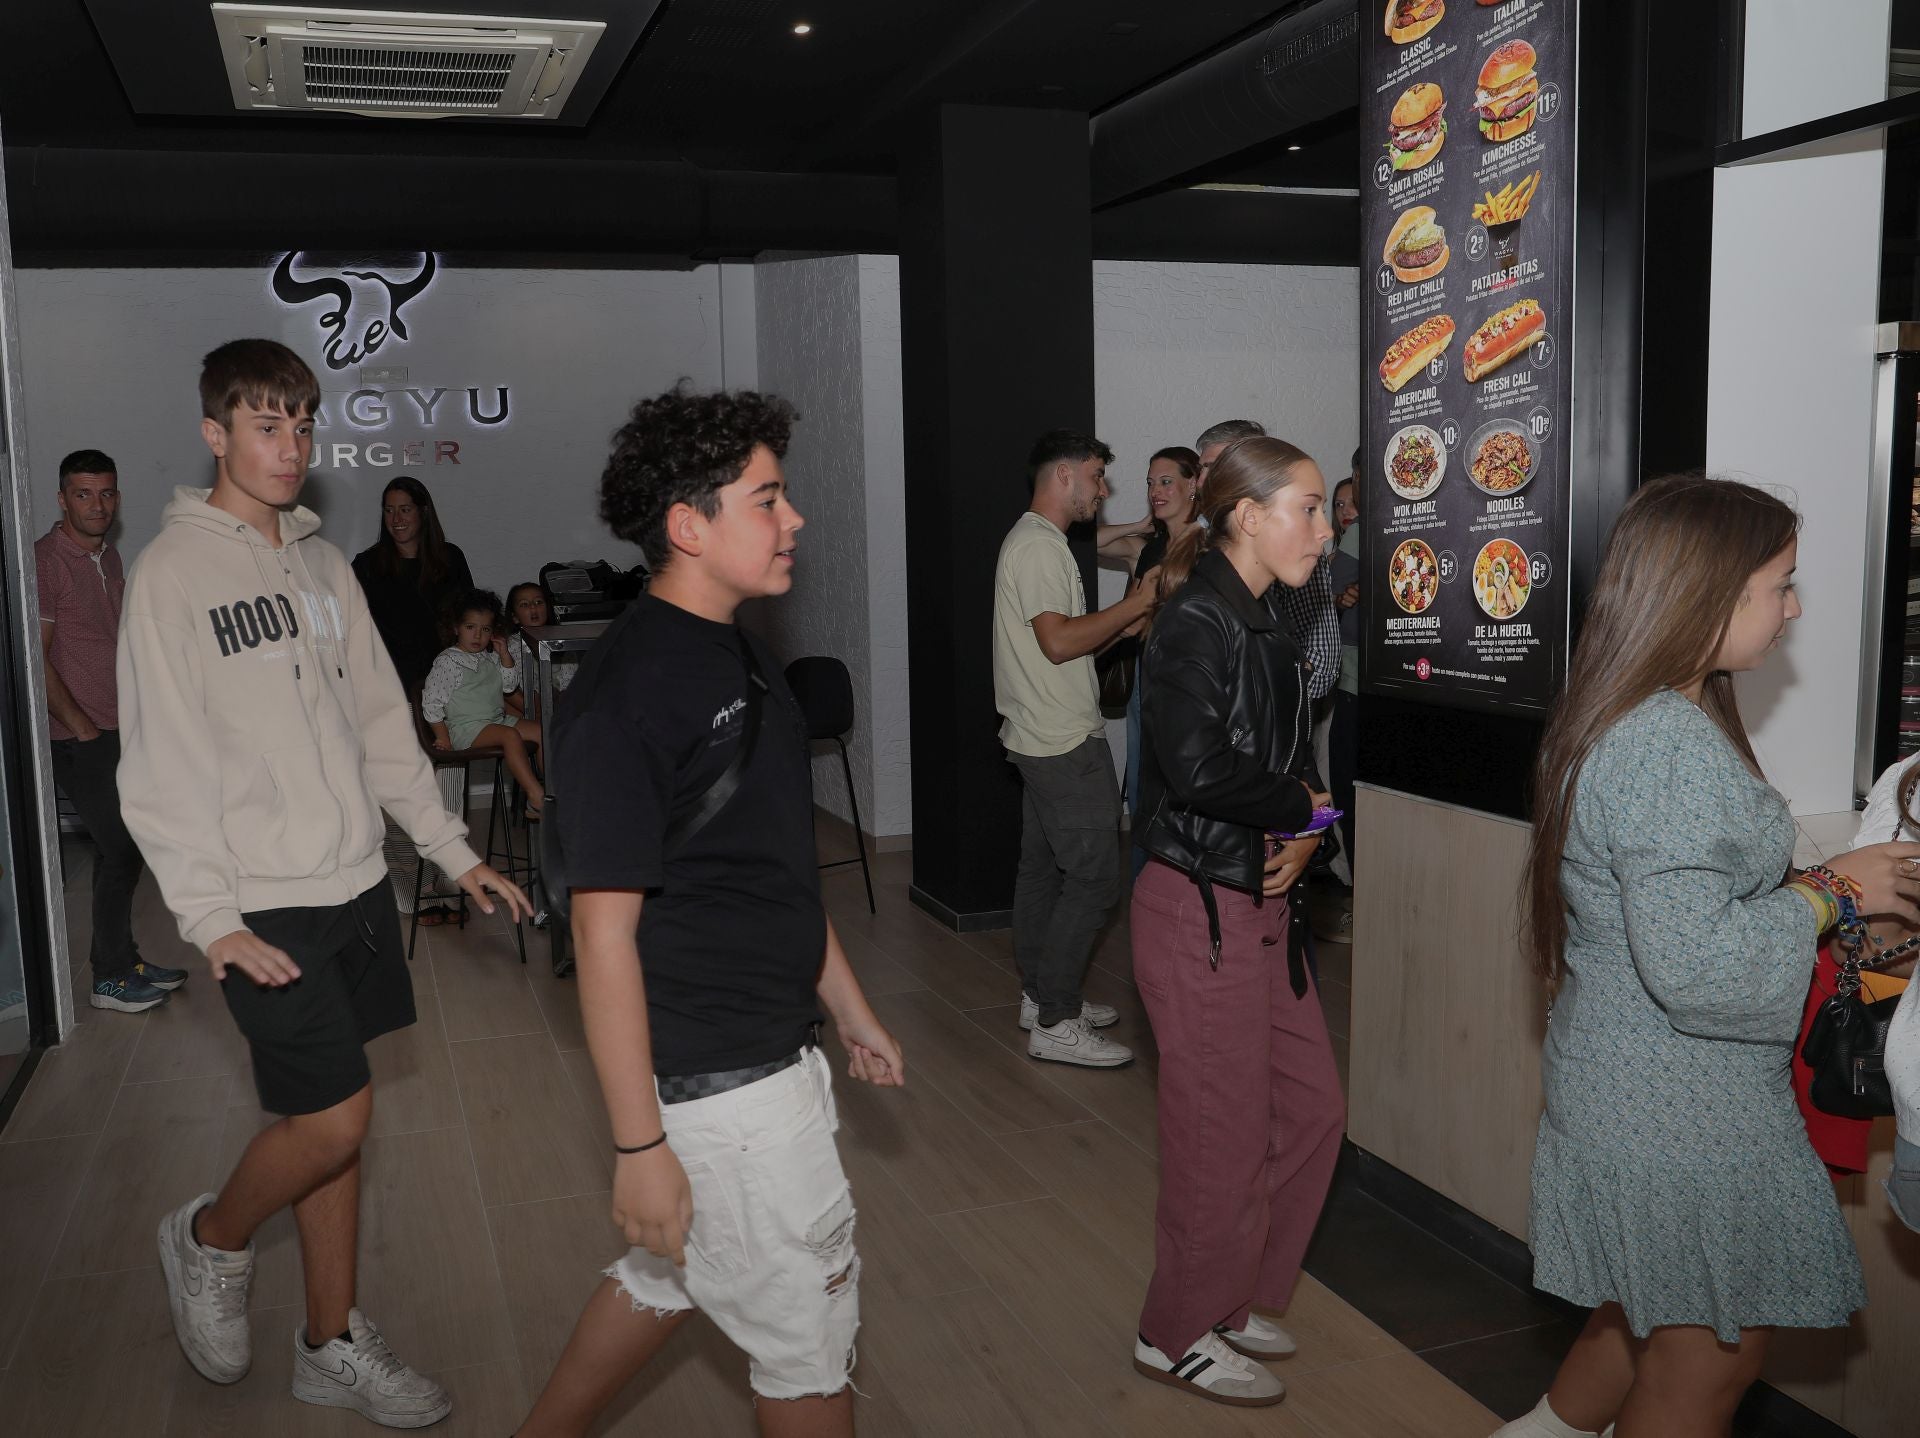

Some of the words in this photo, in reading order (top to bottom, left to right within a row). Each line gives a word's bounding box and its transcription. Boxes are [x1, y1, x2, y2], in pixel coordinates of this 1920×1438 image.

[1494, 0, 1525, 24] ITALIAN
[1401, 37, 1431, 64] CLASSIC
[1482, 131, 1537, 166] KIMCHEESSE
[1389, 176, 1411, 196] SANTA
[1413, 160, 1444, 185] ROSALÍA
[1472, 269, 1507, 292] PATATAS
[1508, 259, 1538, 280] FRITAS
[1388, 292, 1402, 307] RED
[1404, 286, 1418, 301] HOT
[1420, 277, 1445, 296] CHILLY
[1484, 376, 1510, 394] FRESH
[1513, 371, 1530, 387] CALI
[313, 387, 510, 428] GYU
[1395, 386, 1436, 407] AMERICANO
[307, 440, 462, 468] URGER
[1394, 504, 1410, 517] WOK
[1412, 500, 1437, 515] ARROZ
[1487, 496, 1524, 514] NOODLES
[208, 593, 299, 657] HOOD
[1387, 617, 1440, 630] MEDITERRANEA
[1475, 626, 1485, 637] DE
[1488, 625, 1497, 637] LA
[1500, 624, 1531, 637] HUERTA
